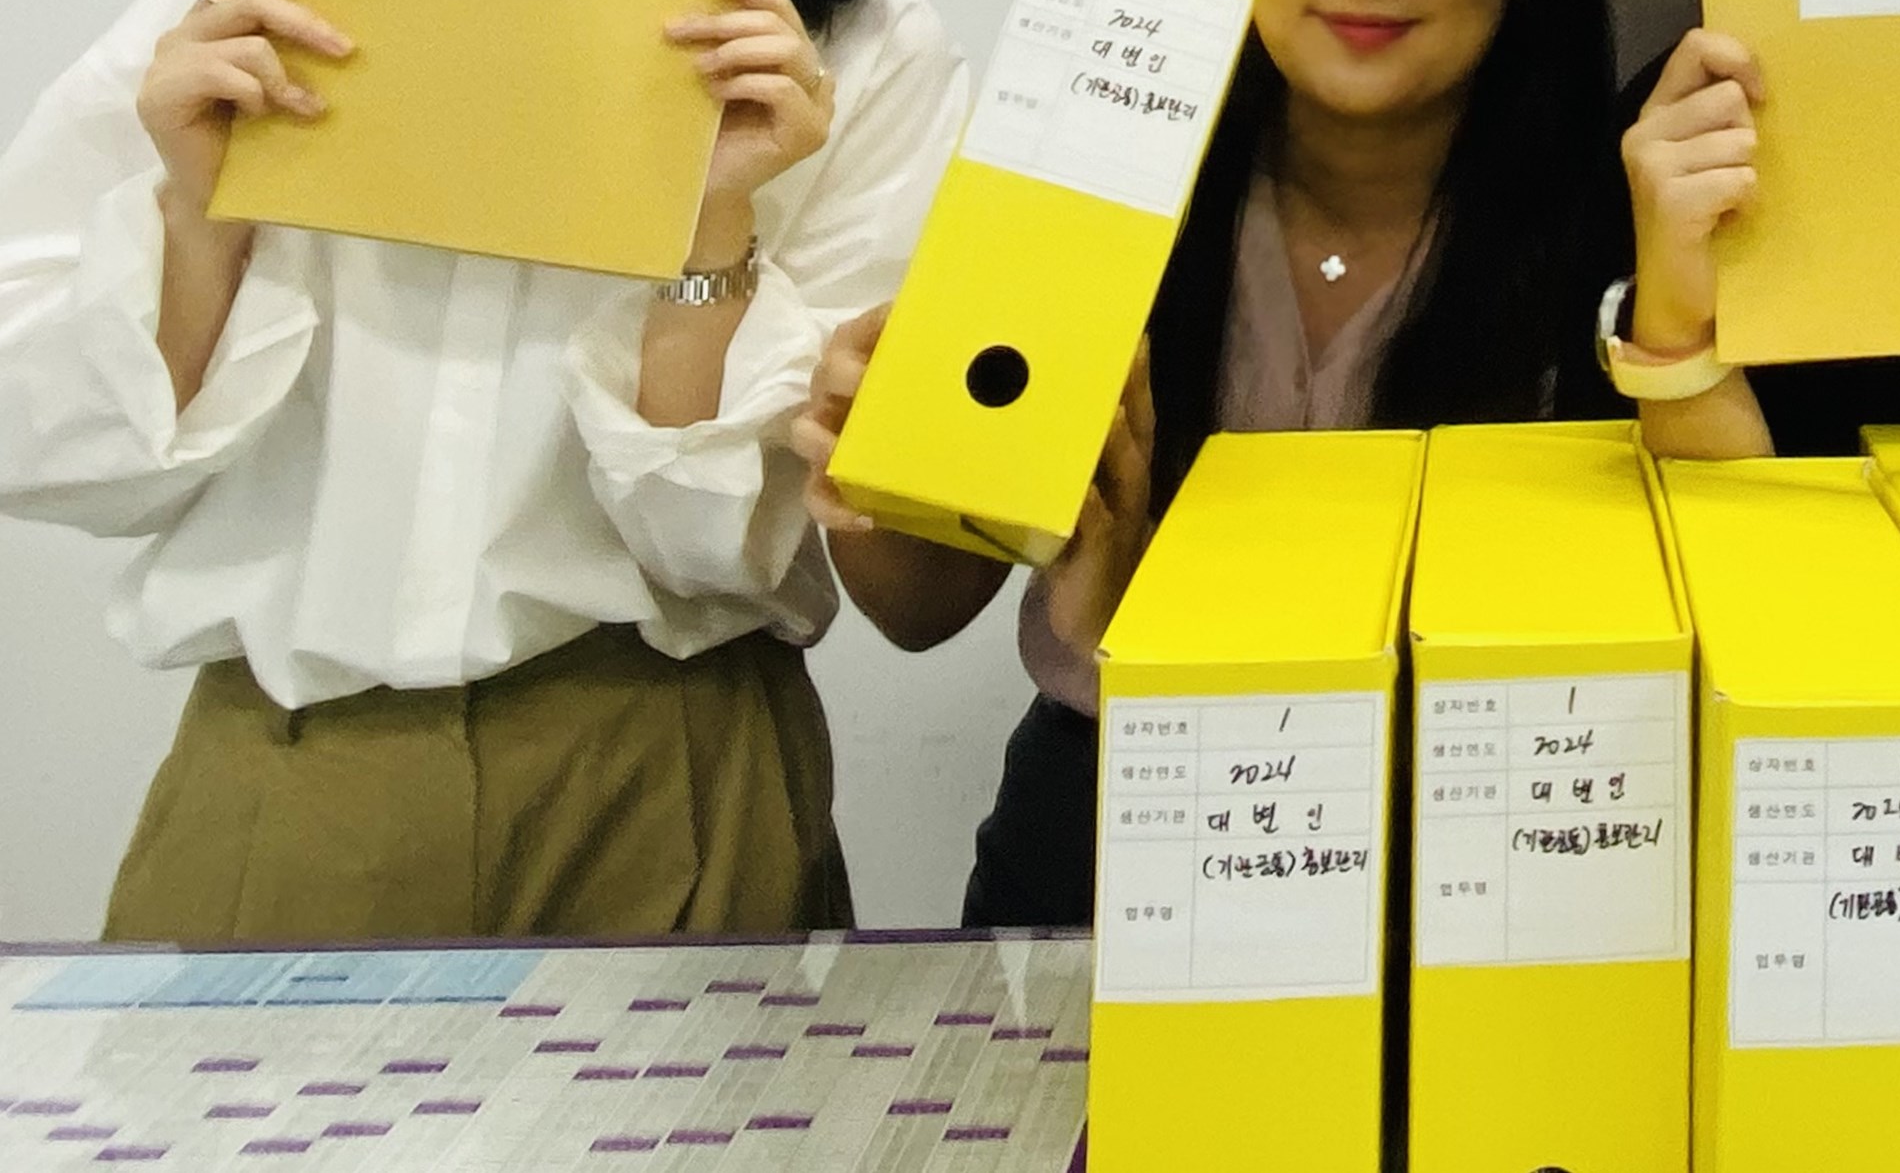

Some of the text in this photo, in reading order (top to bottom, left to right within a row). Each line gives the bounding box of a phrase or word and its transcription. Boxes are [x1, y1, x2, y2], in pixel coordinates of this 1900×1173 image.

[1108, 9, 1163, 36] 2024
[1568, 686, 1576, 714] 1
[1279, 707, 1291, 732] 1
[1534, 729, 1594, 756] 2024
[1230, 755, 1296, 785] 2024
